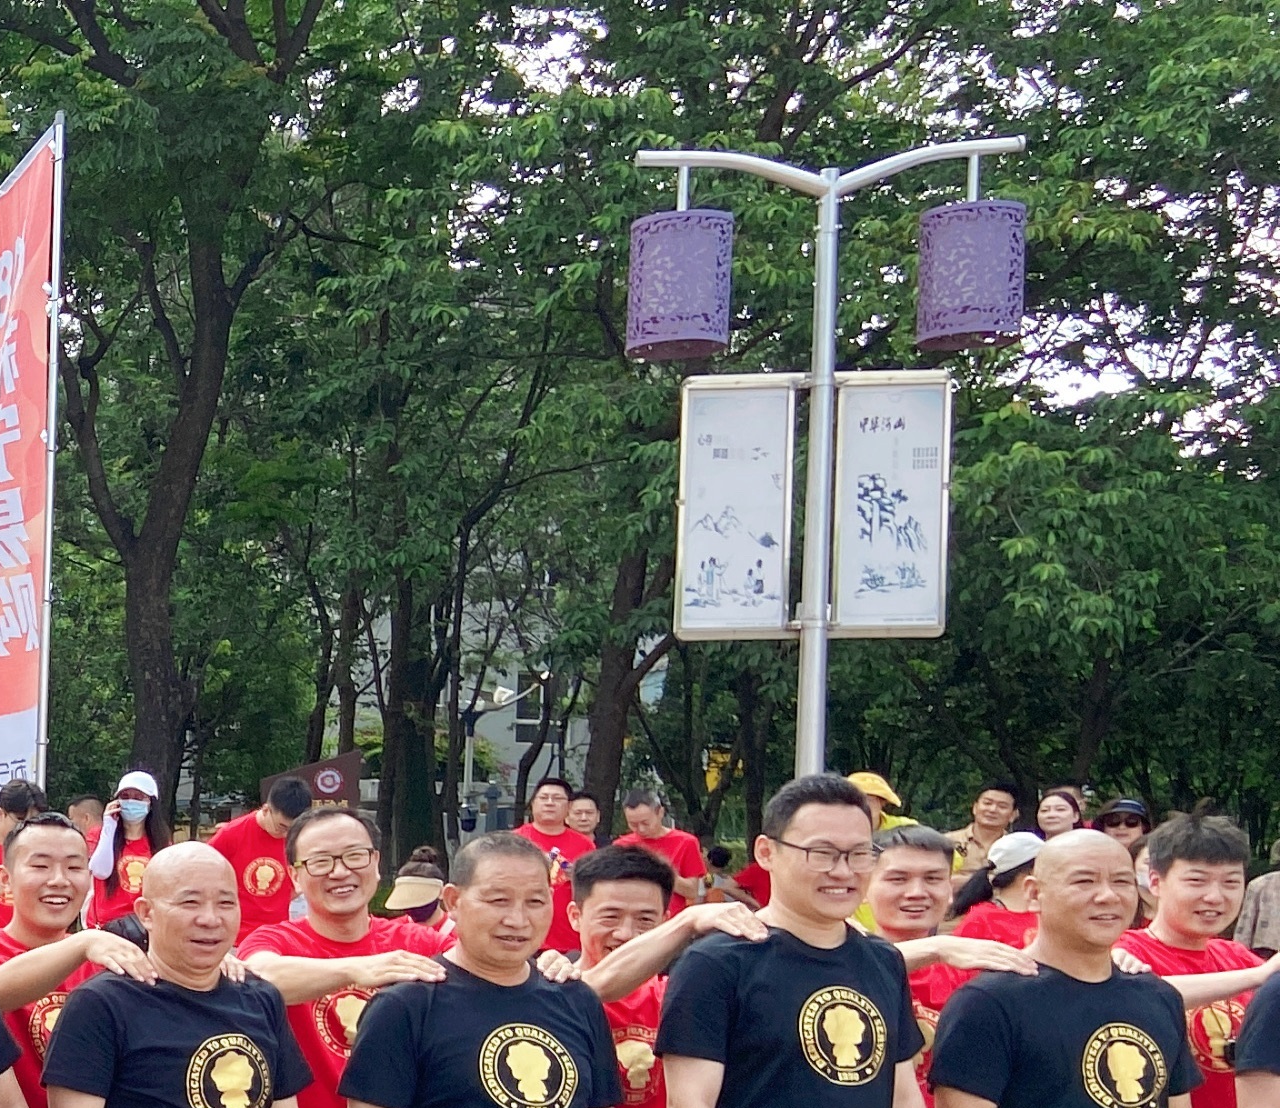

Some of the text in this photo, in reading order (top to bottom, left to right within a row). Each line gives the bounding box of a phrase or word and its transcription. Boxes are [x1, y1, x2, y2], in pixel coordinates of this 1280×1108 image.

[206, 1041, 220, 1053] TO
[484, 1037, 509, 1103] DEDICATED
[497, 1028, 513, 1040] TO
[515, 1027, 564, 1054] QUALITY
